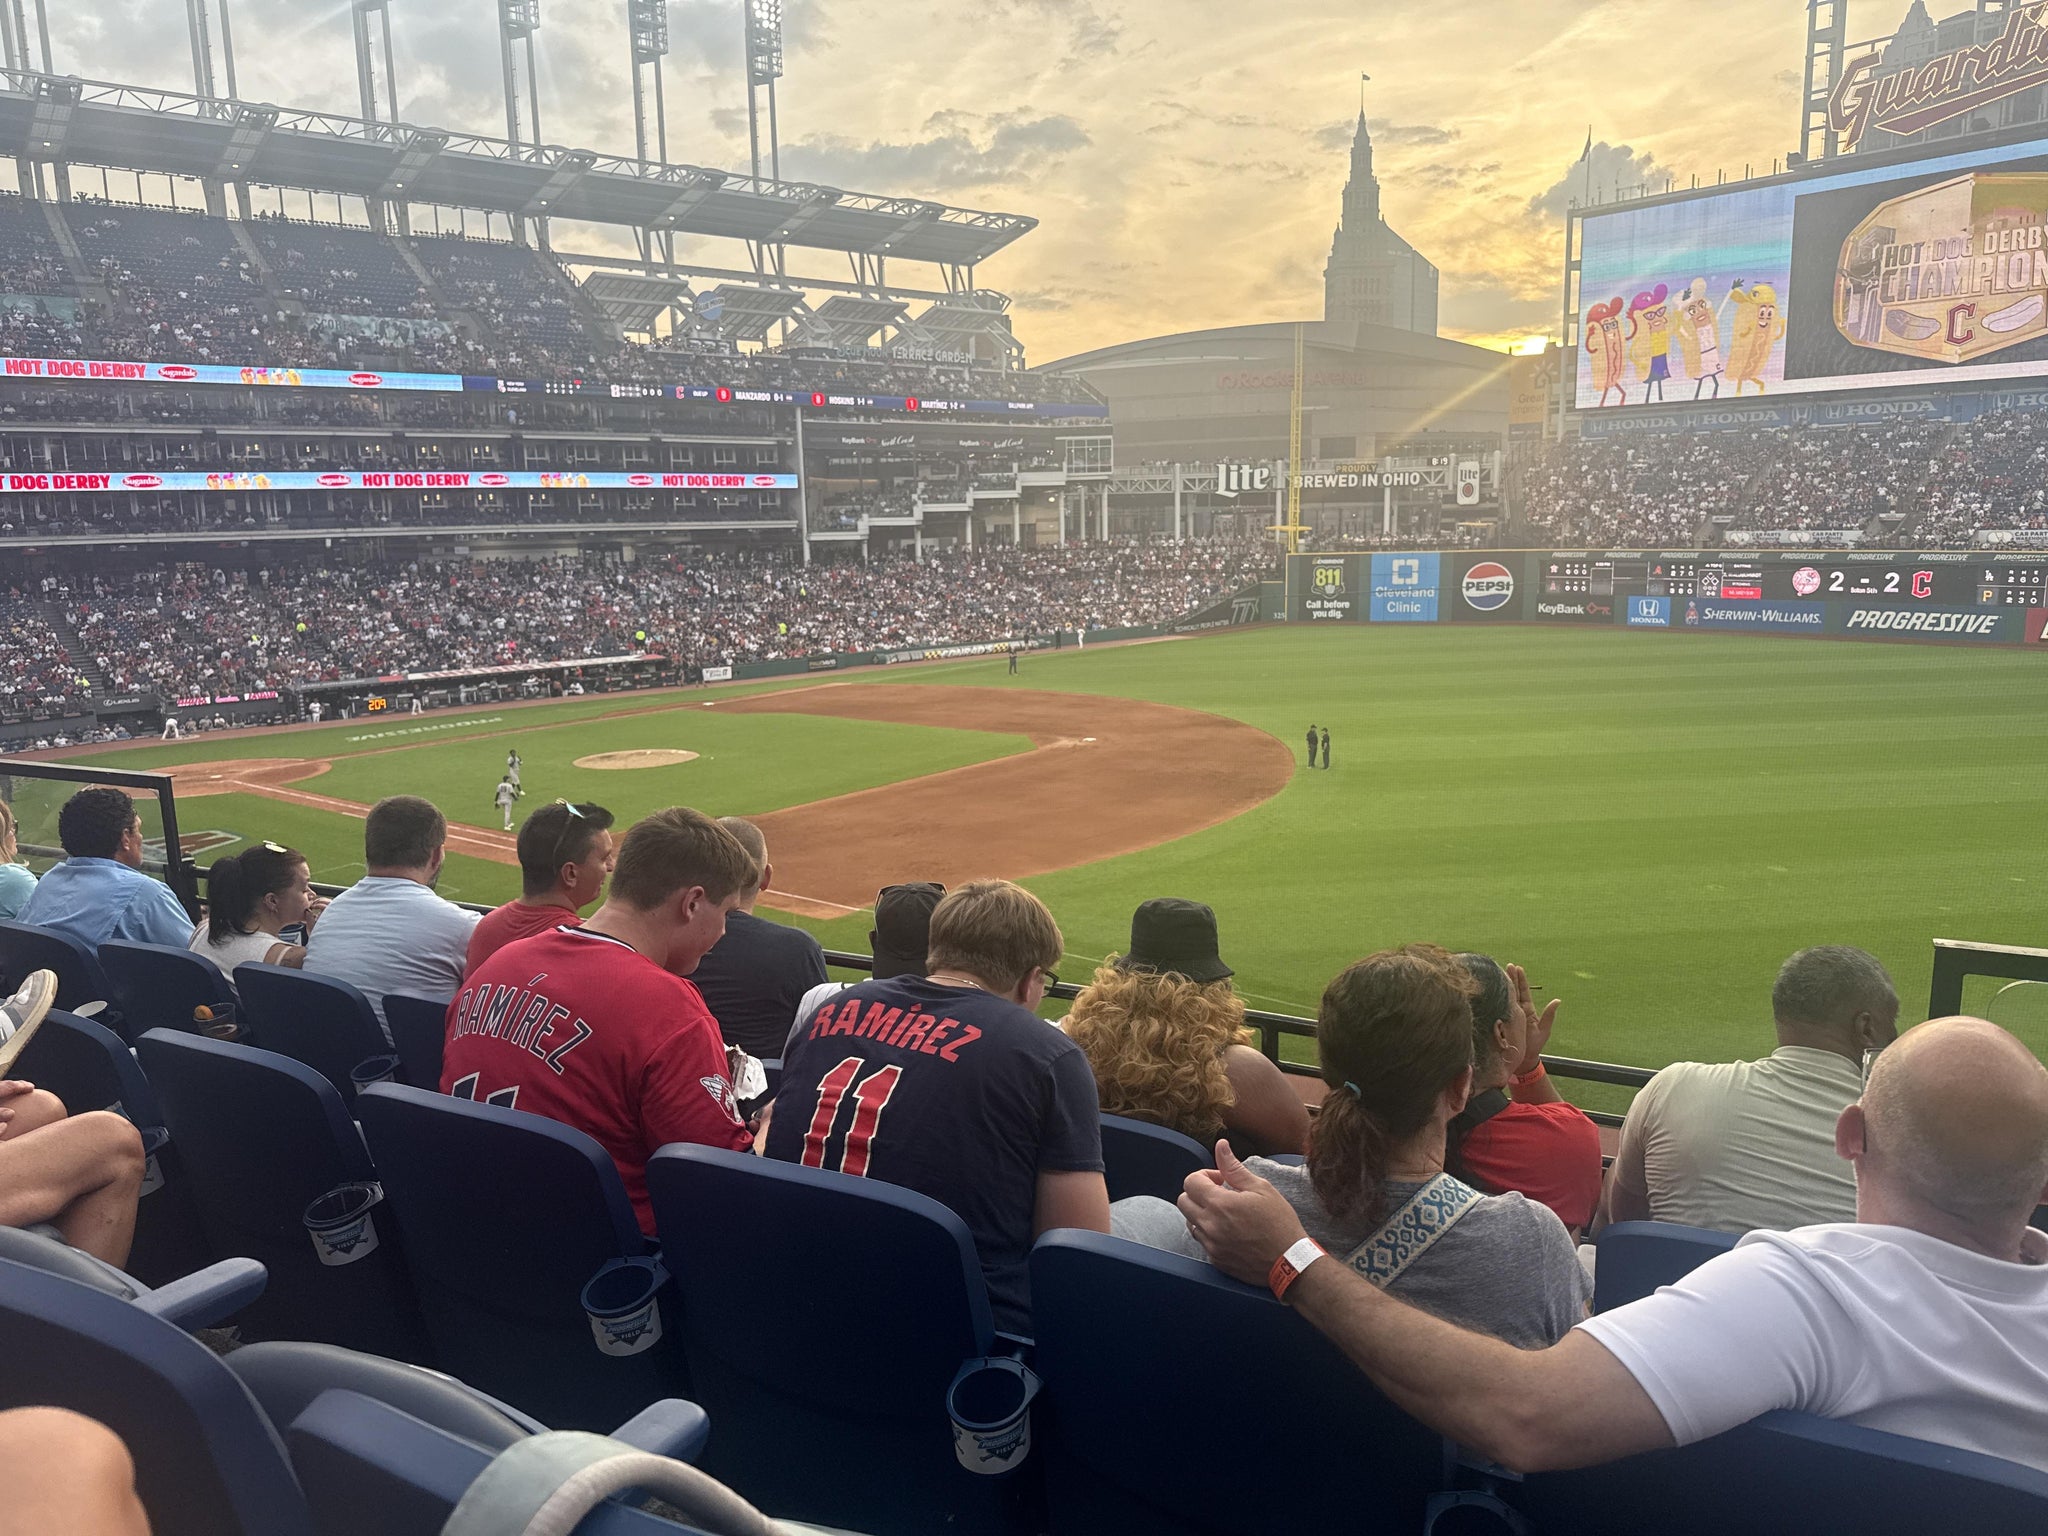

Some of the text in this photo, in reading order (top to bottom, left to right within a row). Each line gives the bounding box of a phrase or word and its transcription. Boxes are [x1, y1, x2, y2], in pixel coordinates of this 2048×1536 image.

[1884, 241, 1924, 268] HOT
[1932, 235, 1973, 261] DOG
[1945, 302, 1977, 346] C
[892, 346, 933, 361] TERRACE
[935, 351, 973, 364] GARDEN
[5, 359, 146, 378] HOT DOG DERBY
[160, 367, 197, 378] Sugardale
[735, 392, 770, 402] MANZARDO
[829, 396, 854, 406] HOSKINS
[1846, 400, 1937, 417] HONDA
[1607, 416, 1678, 431] HONDA
[1703, 410, 1780, 424] HONDA
[1432, 457, 1448, 466] 8:19
[1336, 464, 1378, 474] PROUDLY
[1460, 469, 1478, 482] Lite
[10, 475, 48, 489] DOG
[52, 474, 111, 490] DERBY
[362, 474, 470, 486] HOT DOG DERBY
[662, 475, 685, 486] HOT
[688, 476, 710, 486] DOG
[712, 476, 746, 487] DERBY
[1215, 464, 1270, 498] Lite
[1294, 472, 1420, 489] BREWED IN OHIO
[1316, 568, 1340, 586] 811
[1828, 571, 1844, 592] 2
[1884, 572, 1900, 592] 2
[1912, 570, 1933, 598] C
[1376, 586, 1435, 598] Cleveland
[1466, 581, 1510, 592] PEPSI
[1982, 590, 1992, 602] P
[1306, 600, 1350, 608] Call before
[1387, 602, 1421, 612] Clinic
[1538, 602, 1584, 616] KeyBank
[1312, 609, 1344, 620] you dig.
[1846, 610, 2000, 634] PROGRESSIVE
[453, 973, 593, 1077] RAMÍREZ
[808, 1000, 983, 1063] RAMÍREZ
[799, 1056, 904, 1178] 11
[337, 1240, 356, 1250] FIELD
[621, 1330, 642, 1338] FIELD
[996, 1442, 1016, 1455] FIELD
